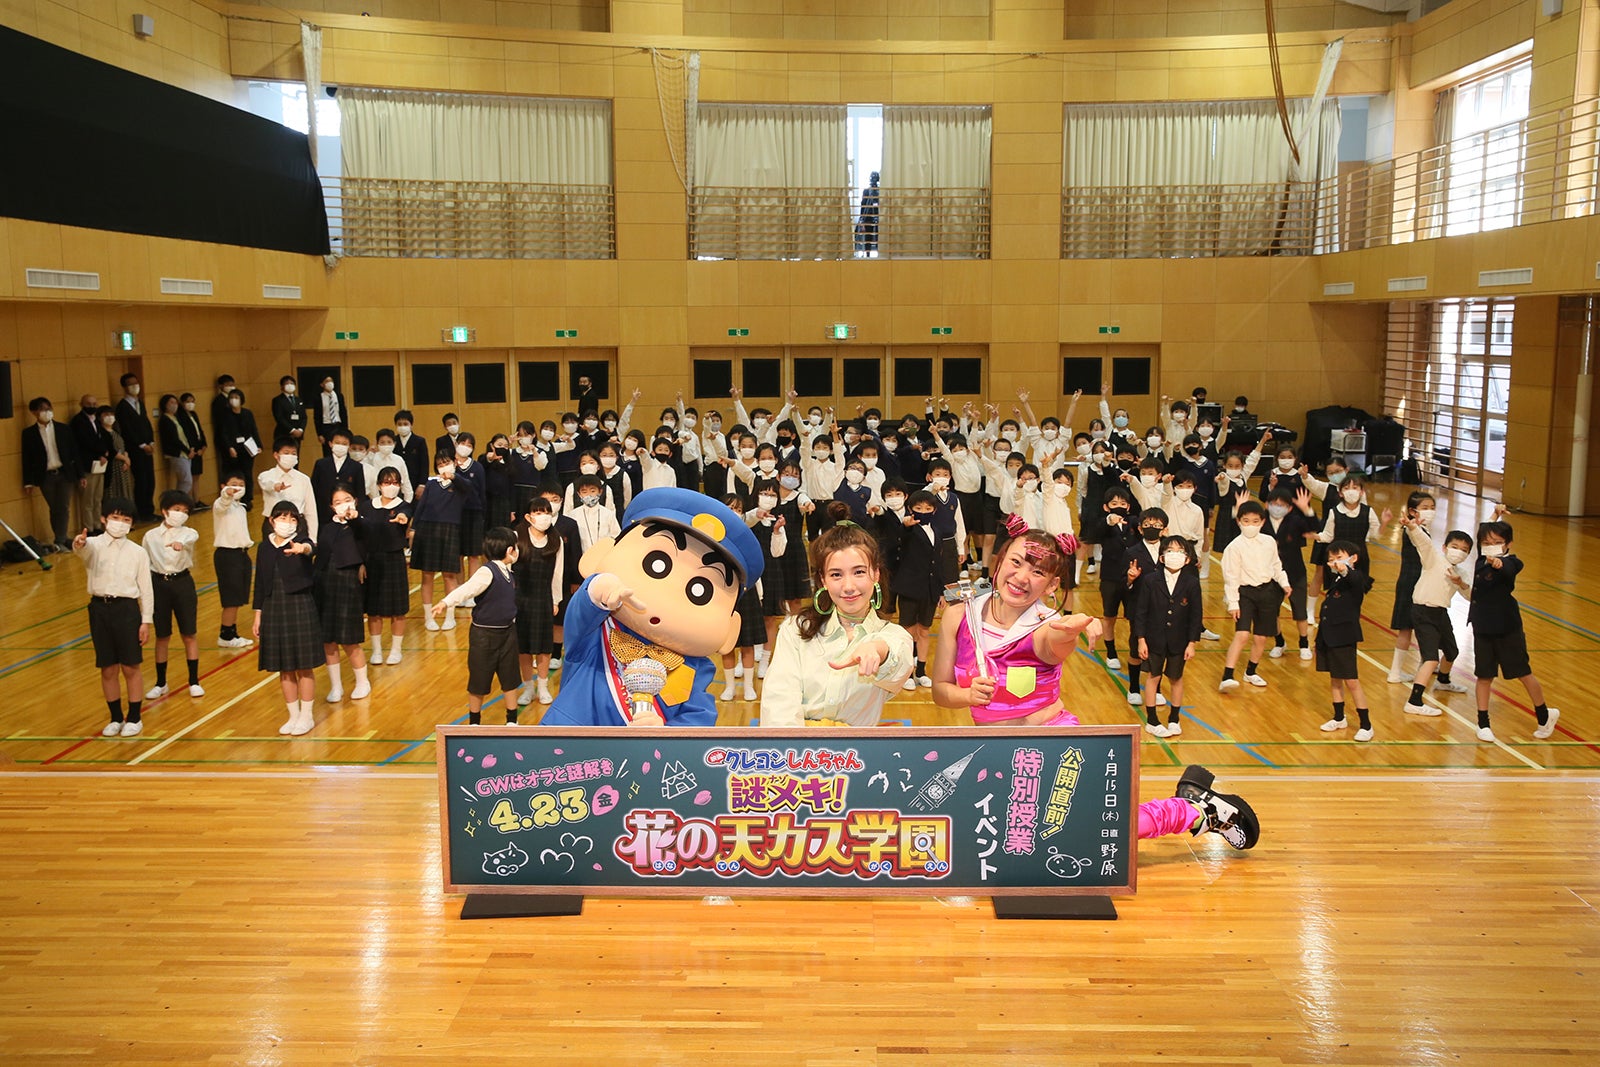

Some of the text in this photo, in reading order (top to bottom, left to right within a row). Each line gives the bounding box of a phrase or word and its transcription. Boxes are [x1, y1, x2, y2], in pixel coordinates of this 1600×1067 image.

[475, 758, 614, 796] GWはオラと謎解き
[725, 750, 863, 771] クレヨンしんちゃん
[488, 786, 613, 834] 4.23 金
[1002, 747, 1045, 855] 特別授業
[1040, 746, 1085, 840] 公開直前!
[615, 810, 949, 877] 花の天カス学園
[974, 793, 998, 881] イベント
[1101, 828, 1119, 838] 日直
[653, 860, 677, 871] はな
[717, 860, 740, 871] てん
[1100, 842, 1119, 876] 野原
